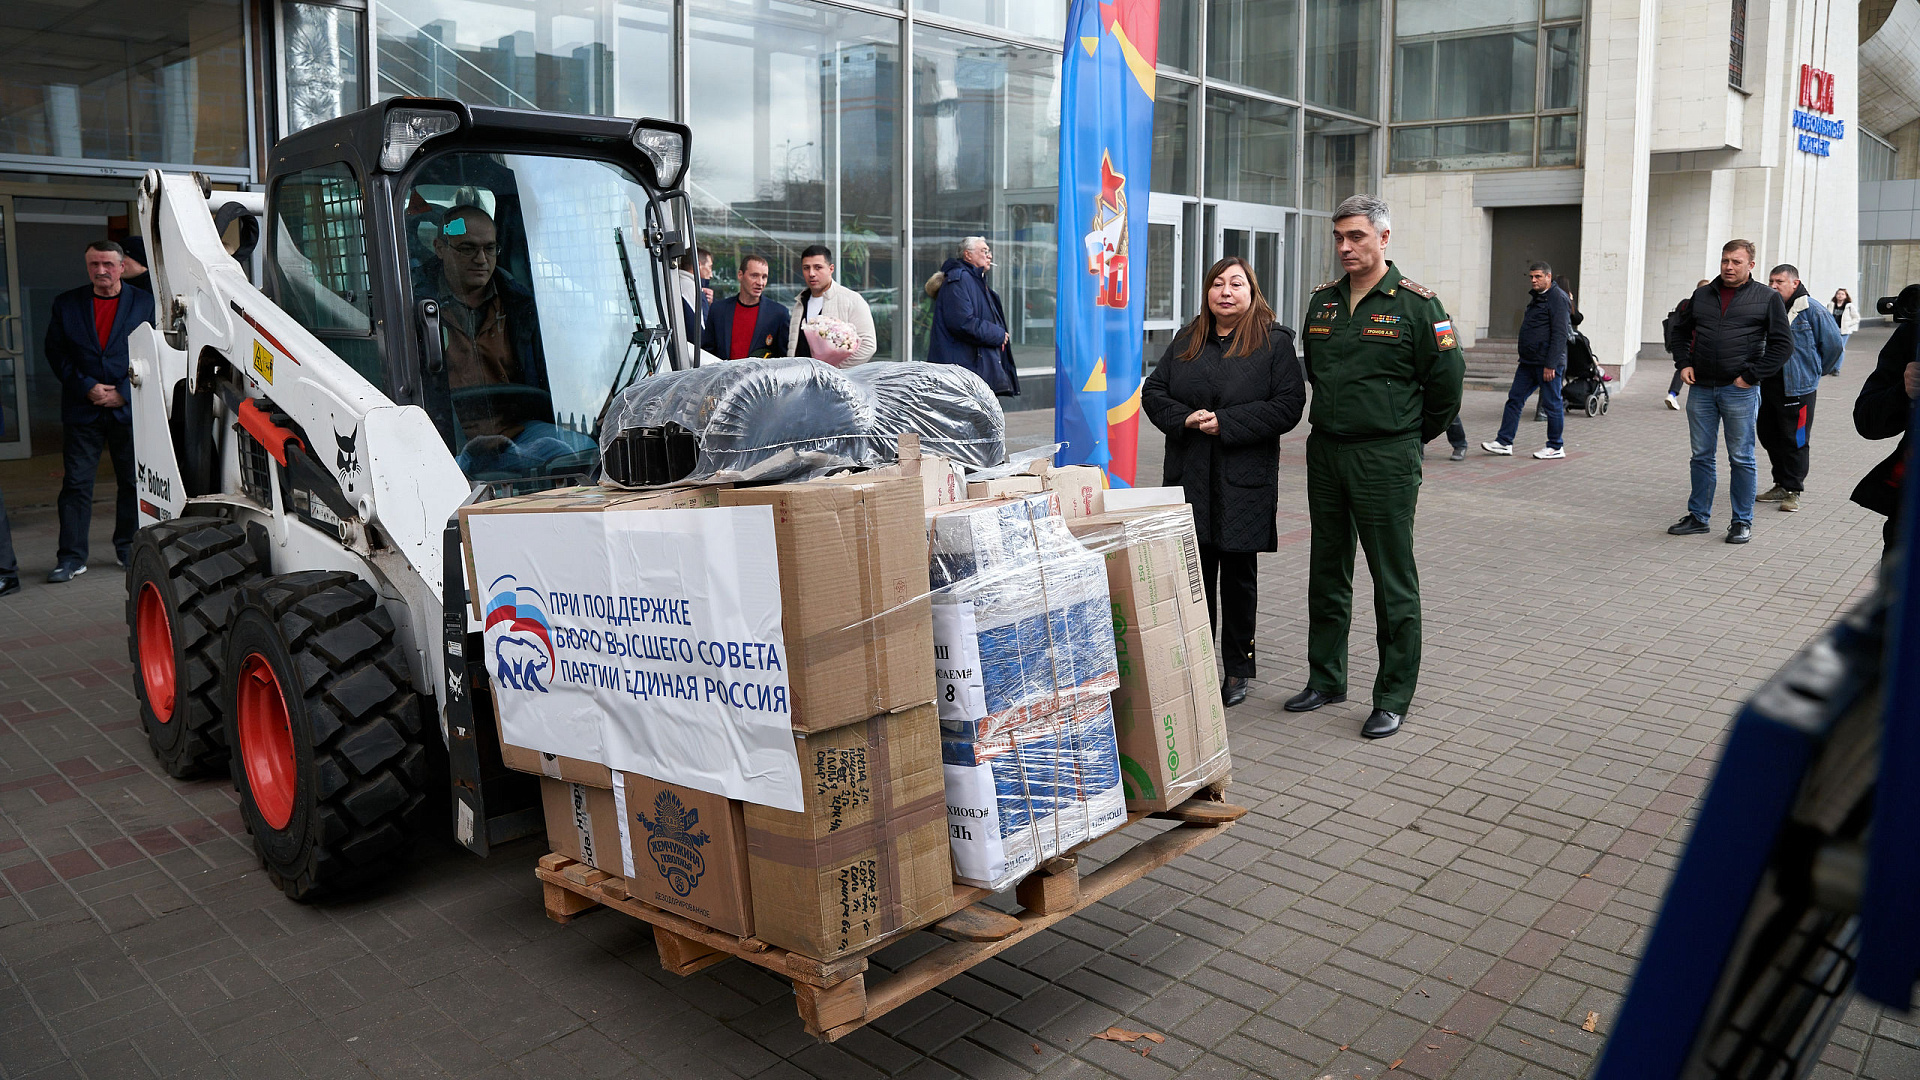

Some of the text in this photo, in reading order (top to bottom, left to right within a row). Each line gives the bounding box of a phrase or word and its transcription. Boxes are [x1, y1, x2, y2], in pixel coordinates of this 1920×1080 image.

[147, 468, 171, 503] Bobcat
[1137, 564, 1146, 583] 250
[549, 592, 692, 627] ПРИ ПОДДЕРЖКЕ
[555, 626, 782, 671] БЮРО ВЫСШЕГО СОВЕТА
[560, 659, 788, 713] ПАРТИИ ЕДИНАЯ РОССИЯ
[936, 668, 972, 680] САЕМ#
[1163, 714, 1180, 781] FOCUS
[948, 823, 973, 841] ЧЕ
[650, 840, 700, 868] ЖЕМЧУЖИНА
